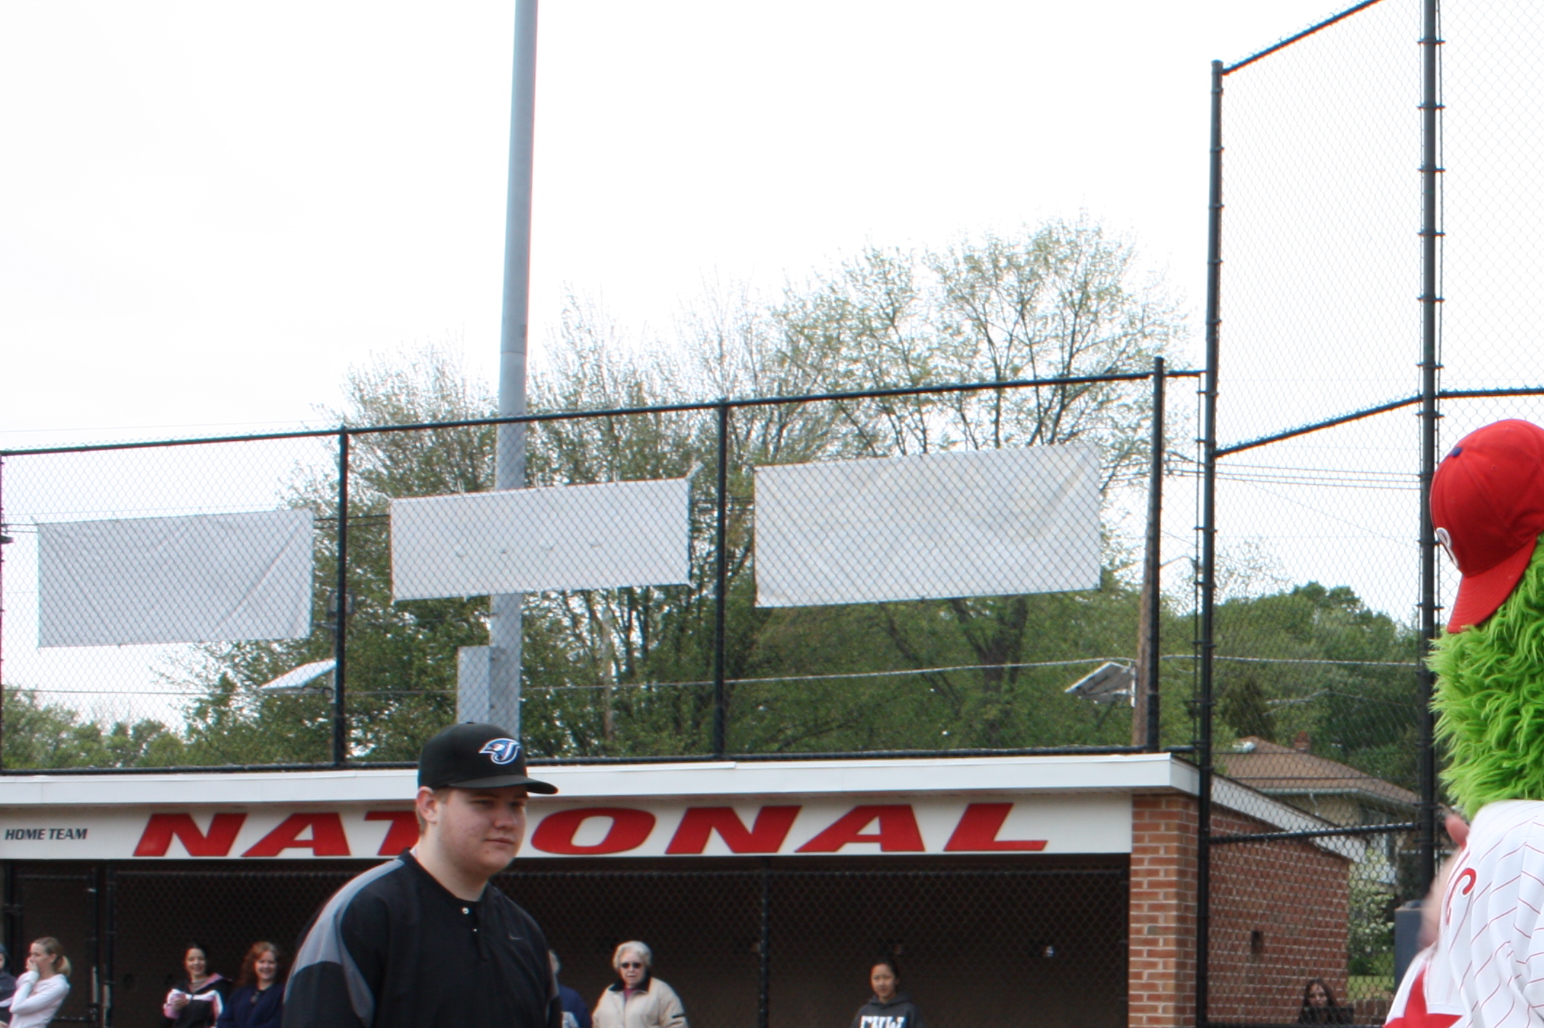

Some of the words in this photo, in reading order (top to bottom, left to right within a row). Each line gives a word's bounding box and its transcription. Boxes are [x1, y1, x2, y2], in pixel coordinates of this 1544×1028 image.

[5, 828, 46, 840] HOME
[49, 828, 88, 840] TEAM
[132, 803, 1048, 857] NATONAL
